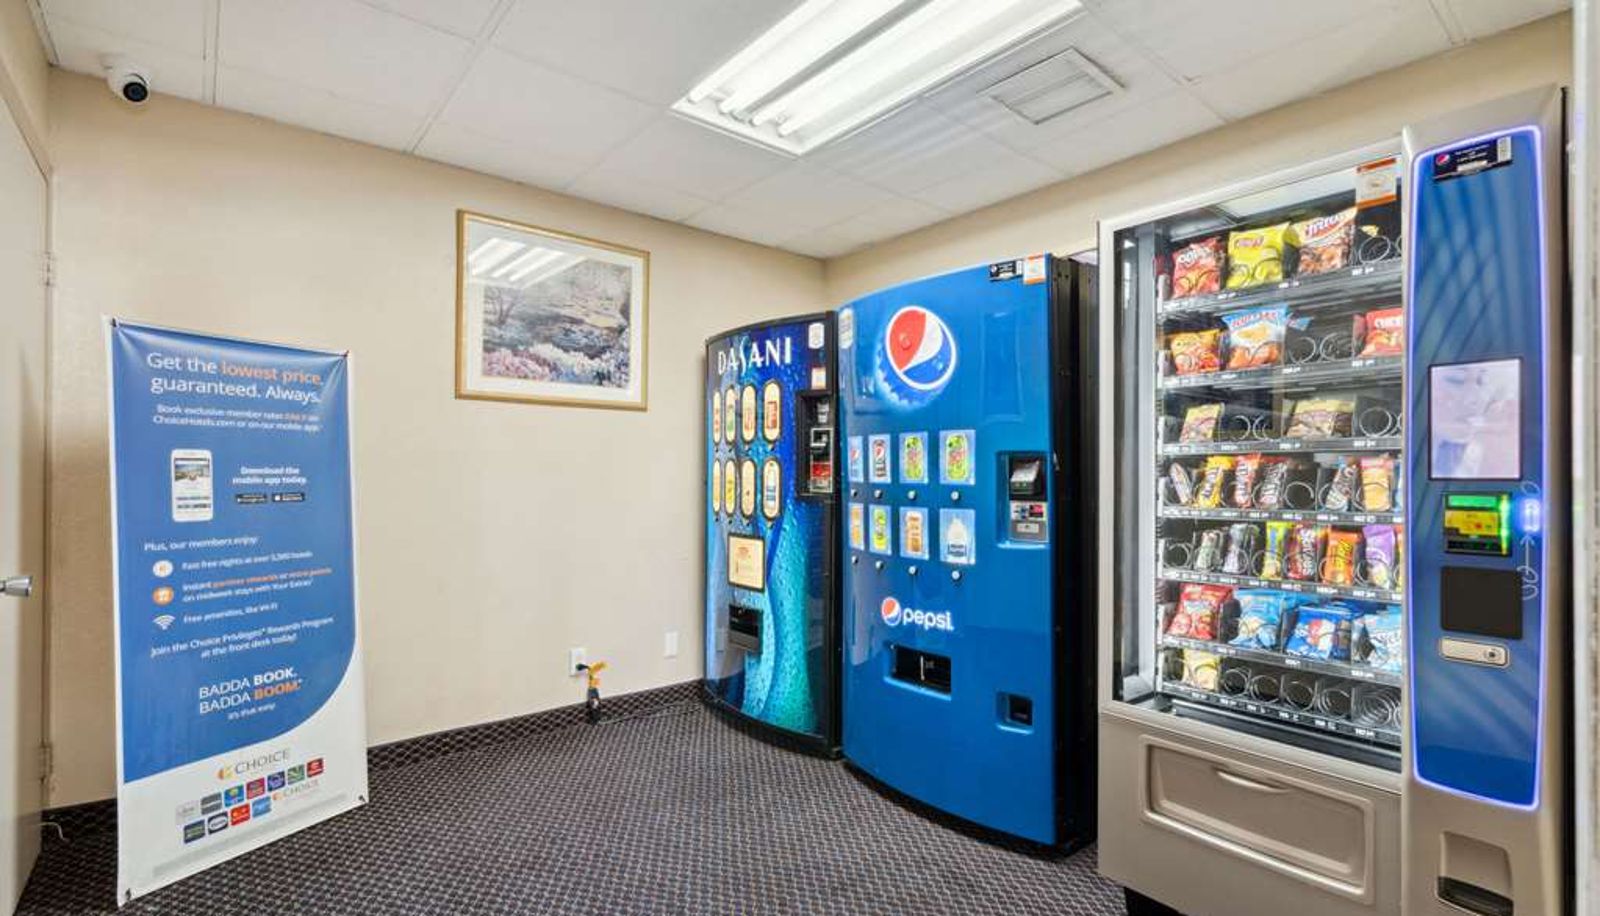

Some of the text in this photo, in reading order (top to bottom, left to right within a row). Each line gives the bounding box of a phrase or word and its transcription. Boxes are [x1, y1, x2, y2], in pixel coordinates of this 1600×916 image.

[147, 352, 182, 371] Get
[187, 357, 217, 375] the
[220, 361, 277, 381] lowest
[717, 336, 792, 376] DASANI
[150, 376, 322, 406] guaranteed. Always.
[152, 415, 235, 429] ChoiceHotels.com
[157, 403, 182, 415] Book
[184, 406, 225, 418] exclusive
[227, 408, 262, 419] member
[232, 476, 263, 485] mobile
[264, 478, 280, 487] app
[240, 466, 300, 475] Download the
[144, 541, 168, 552] Plus,
[170, 540, 186, 550] our
[188, 536, 232, 550] members
[182, 581, 212, 592] Instant
[182, 594, 195, 602] on
[903, 606, 953, 632] pepsi
[150, 646, 171, 660] Join
[172, 642, 188, 653] the
[190, 637, 221, 649] Choice
[267, 622, 301, 635] Rewards
[302, 616, 335, 630] Program
[201, 649, 211, 659] at
[212, 646, 227, 656] the
[228, 641, 250, 653] front
[251, 637, 271, 649] desk
[199, 666, 298, 700] BADDA BOOK.
[199, 691, 251, 715] BADDA
[235, 750, 290, 775] CHOICE
